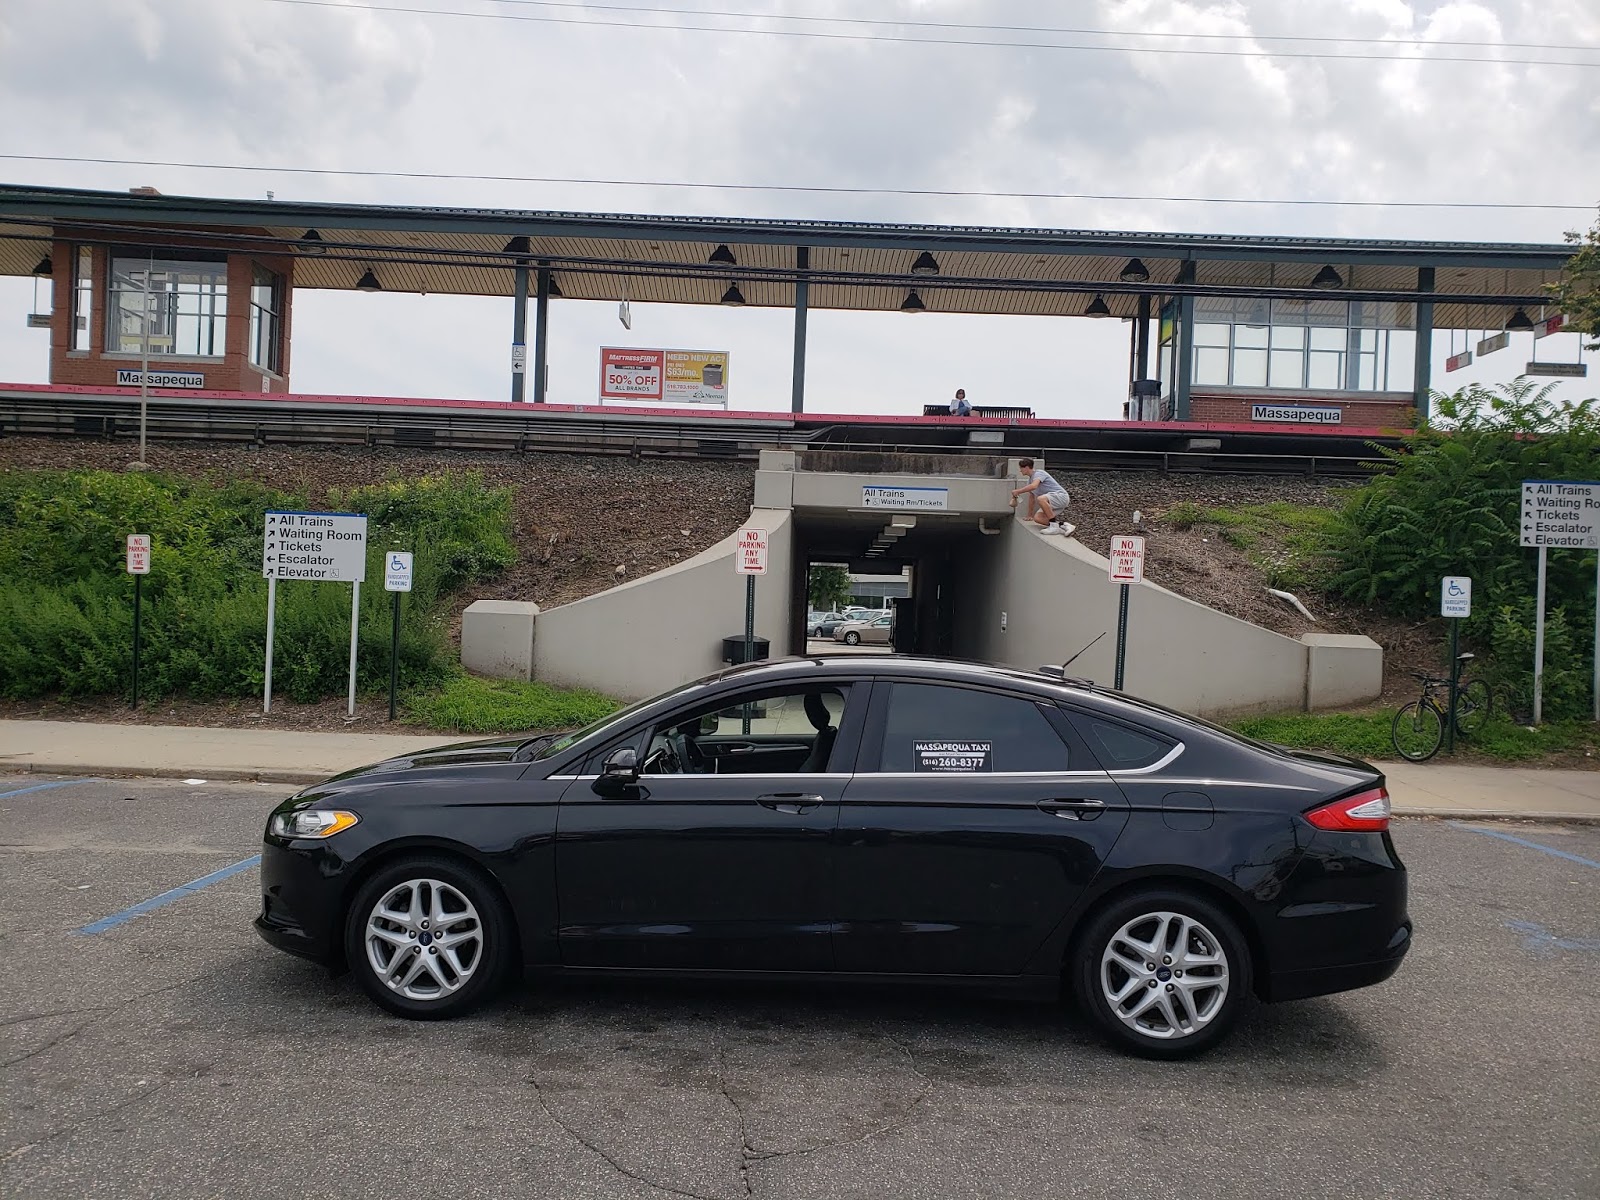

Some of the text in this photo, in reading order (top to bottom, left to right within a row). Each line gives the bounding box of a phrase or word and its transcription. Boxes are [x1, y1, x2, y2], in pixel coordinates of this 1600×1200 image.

[609, 375, 657, 385] 50% OFF
[1254, 407, 1340, 422] Massapequa
[878, 489, 904, 498] Trains
[1537, 485, 1592, 495] All Trains
[1537, 497, 1580, 510] Waiting
[1536, 510, 1580, 520] Tickets
[279, 516, 334, 526] All Trains
[1536, 522, 1592, 533] Escalator
[279, 528, 362, 541] Waiting Room
[746, 532, 758, 540] NO
[1122, 541, 1133, 549] NO
[1535, 535, 1584, 545] Elevator
[279, 541, 322, 552] Tickets
[1113, 550, 1141, 558] PARKING
[278, 554, 334, 565] Escalator
[278, 566, 327, 577] Elevator
[916, 743, 970, 752] MASSAPEQUA
[939, 758, 984, 766] 260-8377
